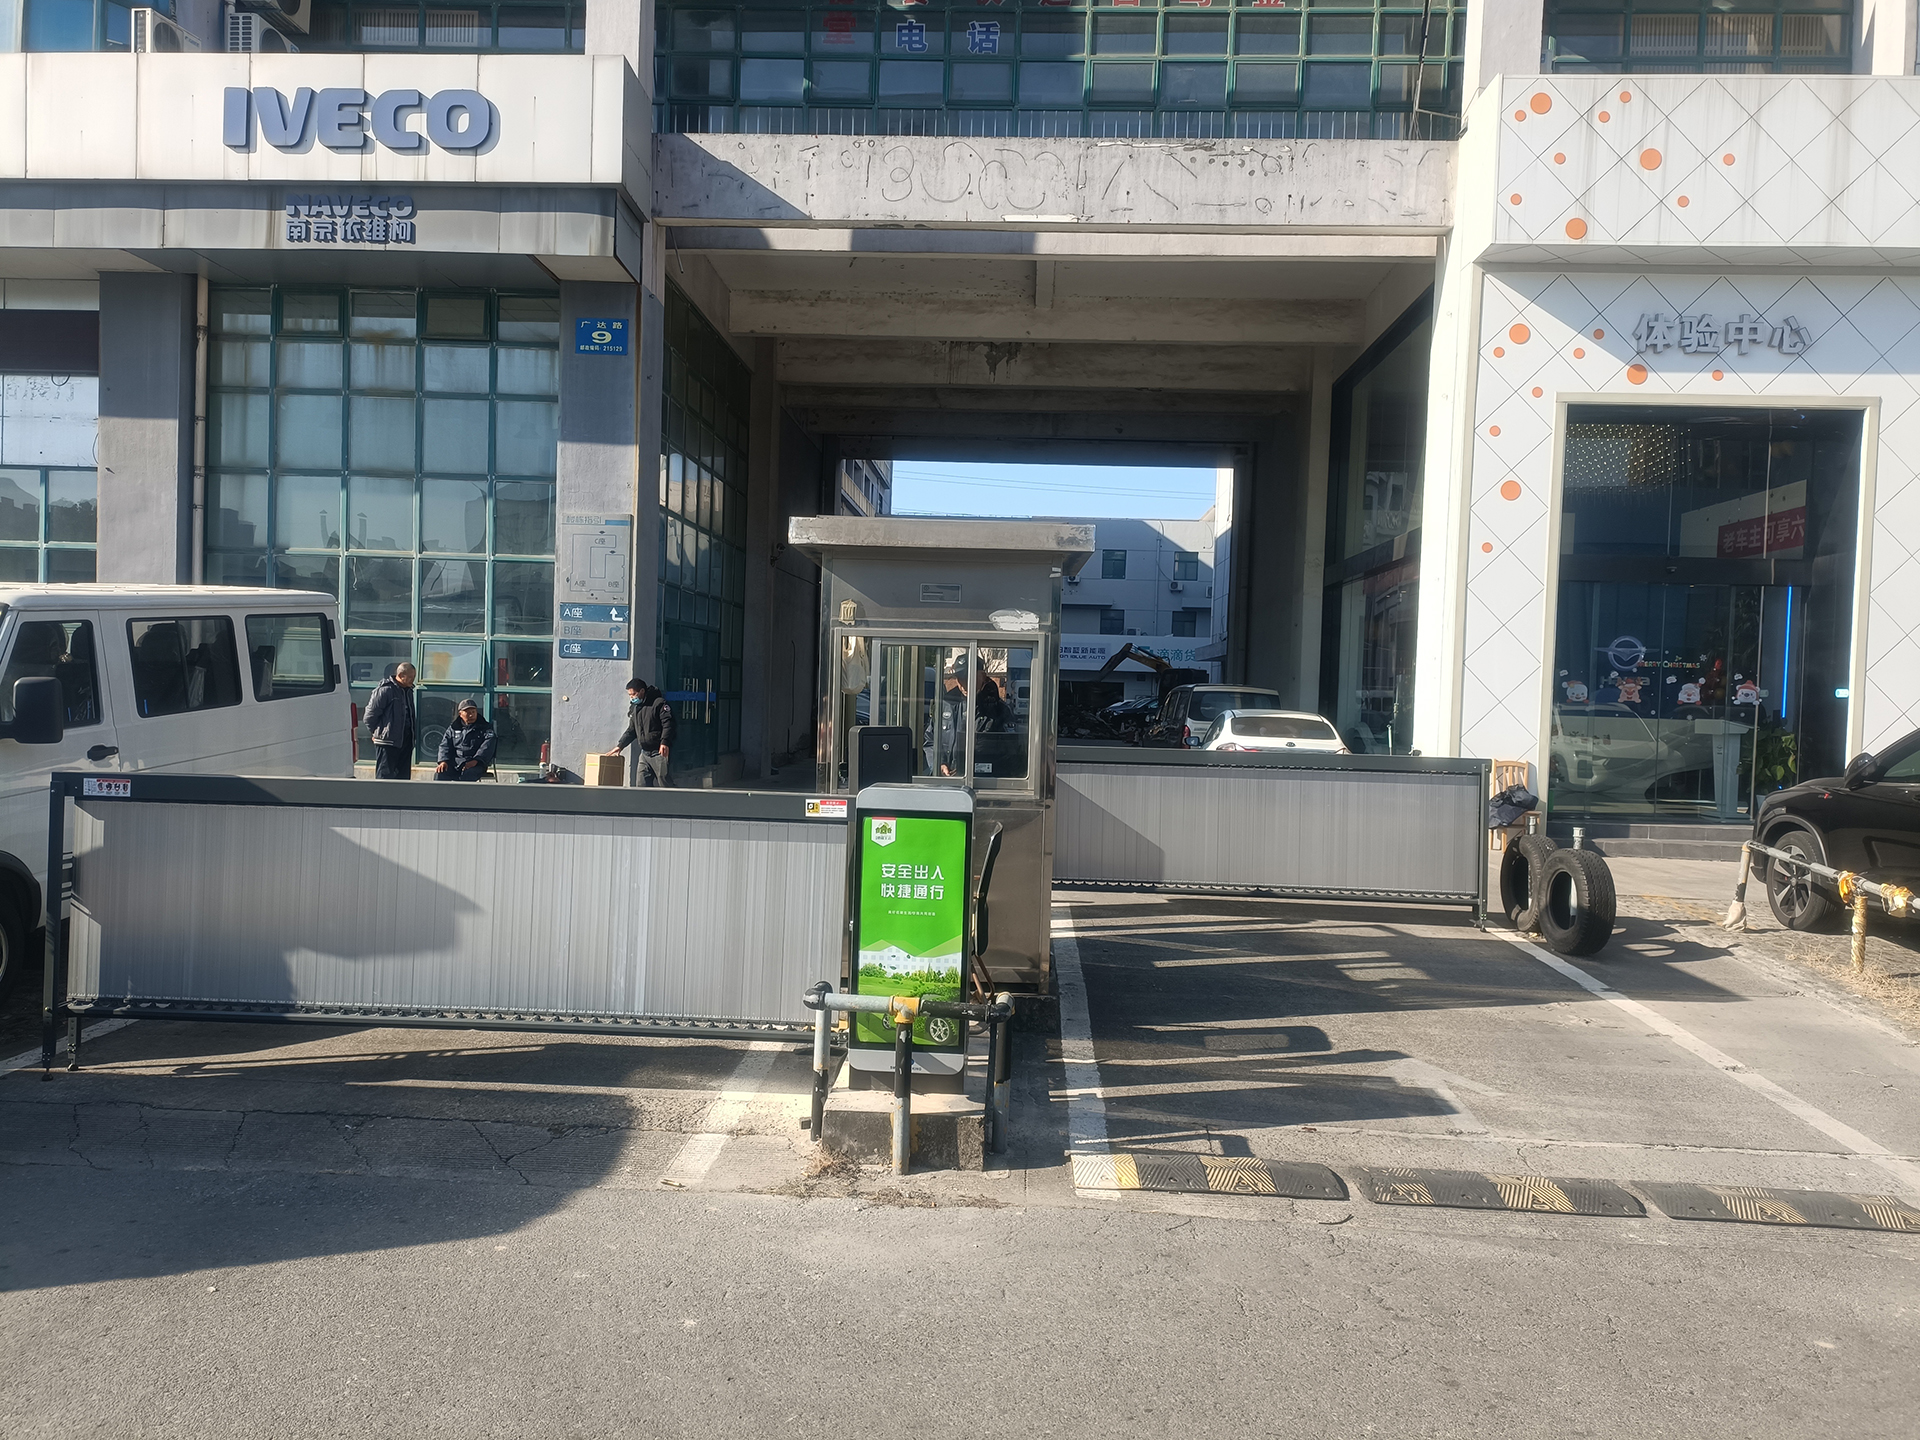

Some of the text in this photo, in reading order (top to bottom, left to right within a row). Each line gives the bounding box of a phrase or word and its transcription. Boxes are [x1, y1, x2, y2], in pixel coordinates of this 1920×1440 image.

[896, 19, 1000, 54] 电话
[223, 86, 492, 149] IVECO
[285, 195, 414, 217] NAVECO
[285, 217, 413, 242] 南京依维柯
[581, 321, 622, 329] 广达路
[591, 330, 612, 344] 9
[1632, 313, 1813, 355] 体验中心
[1723, 514, 1805, 553] 老车主可享六
[563, 606, 583, 619] A座
[563, 624, 582, 636] B座
[563, 642, 582, 654] C座
[881, 863, 944, 880] 安全出入
[880, 883, 944, 900] 快捷通行
